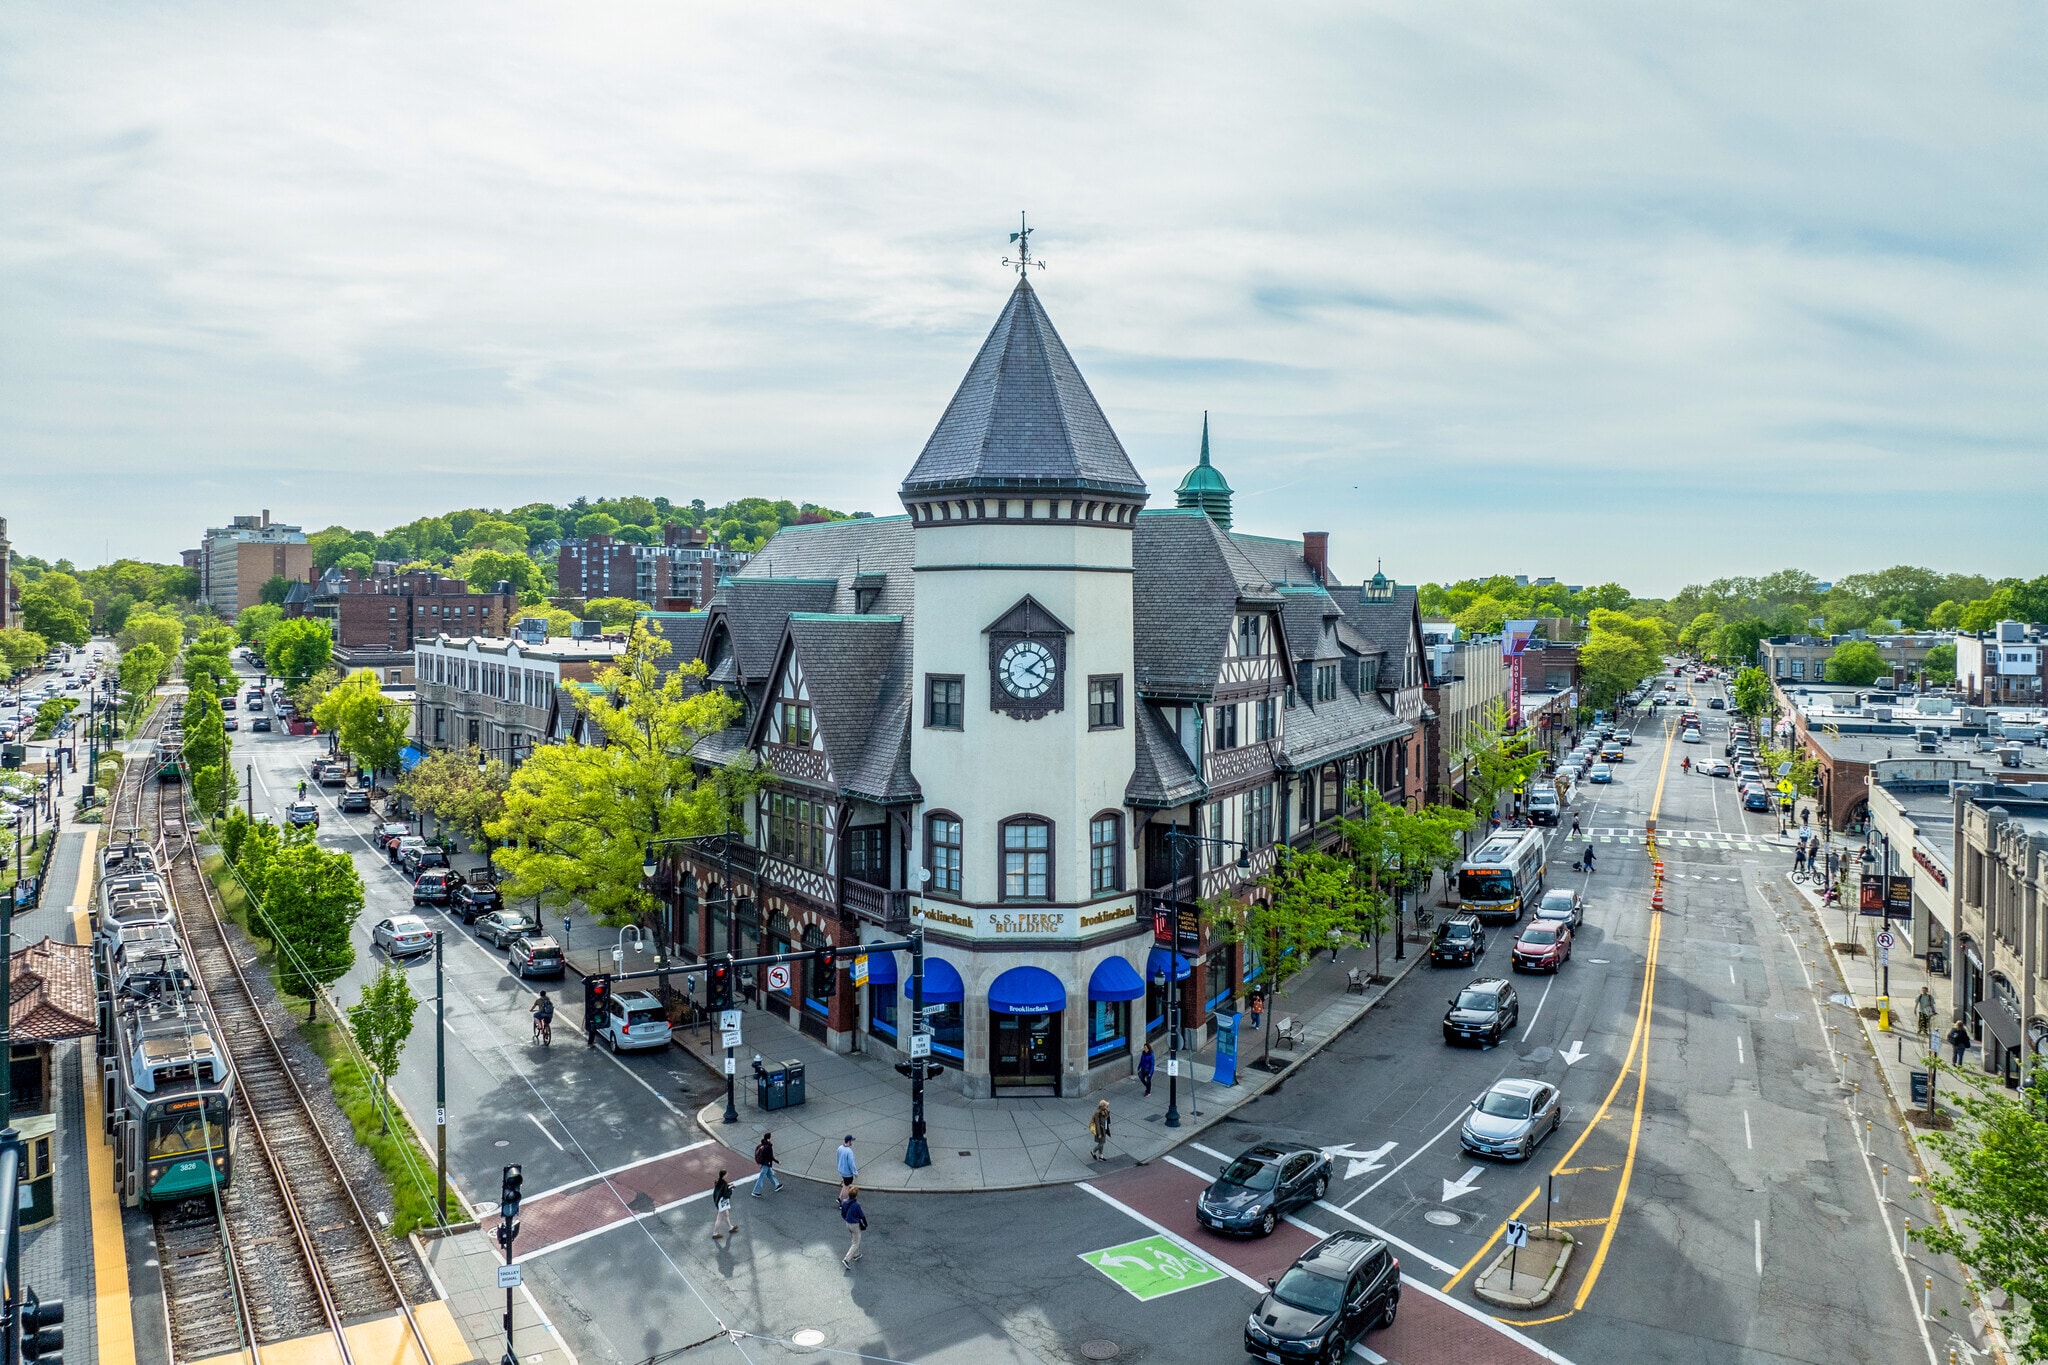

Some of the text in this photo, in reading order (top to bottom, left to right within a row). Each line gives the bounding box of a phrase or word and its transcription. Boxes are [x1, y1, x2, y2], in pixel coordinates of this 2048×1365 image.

[912, 906, 974, 928] BrooklineBank
[990, 914, 1064, 924] S. S. PIERCE
[1080, 904, 1135, 928] BrooklineBank
[996, 923, 1058, 933] BUILDING
[180, 1163, 196, 1171] 3826
